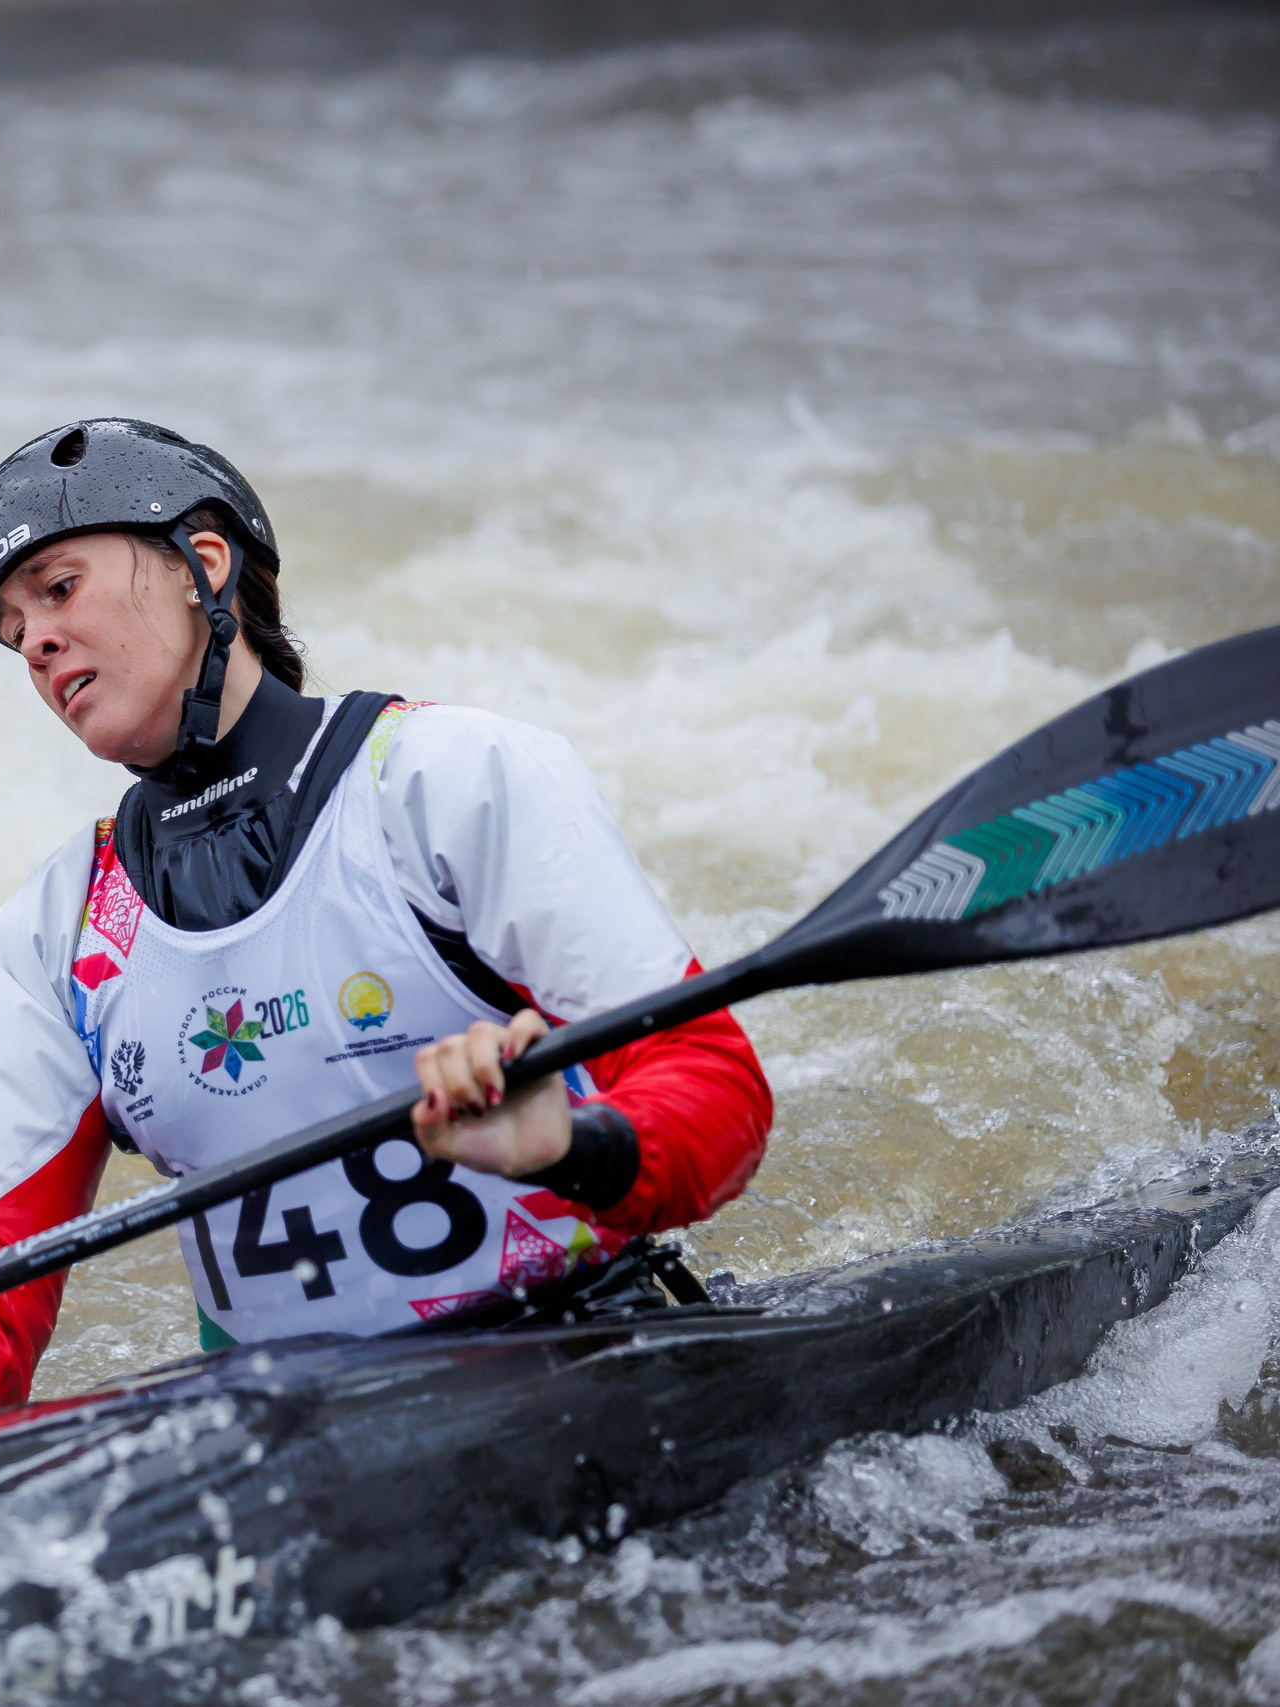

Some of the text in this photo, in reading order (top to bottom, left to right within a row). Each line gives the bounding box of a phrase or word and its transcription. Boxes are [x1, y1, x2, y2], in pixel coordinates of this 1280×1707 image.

[161, 767, 258, 821] sandiline
[255, 989, 309, 1039] 2026
[178, 987, 267, 1096] СПАРТАКИАДА НАРОДОВ РОССИИ
